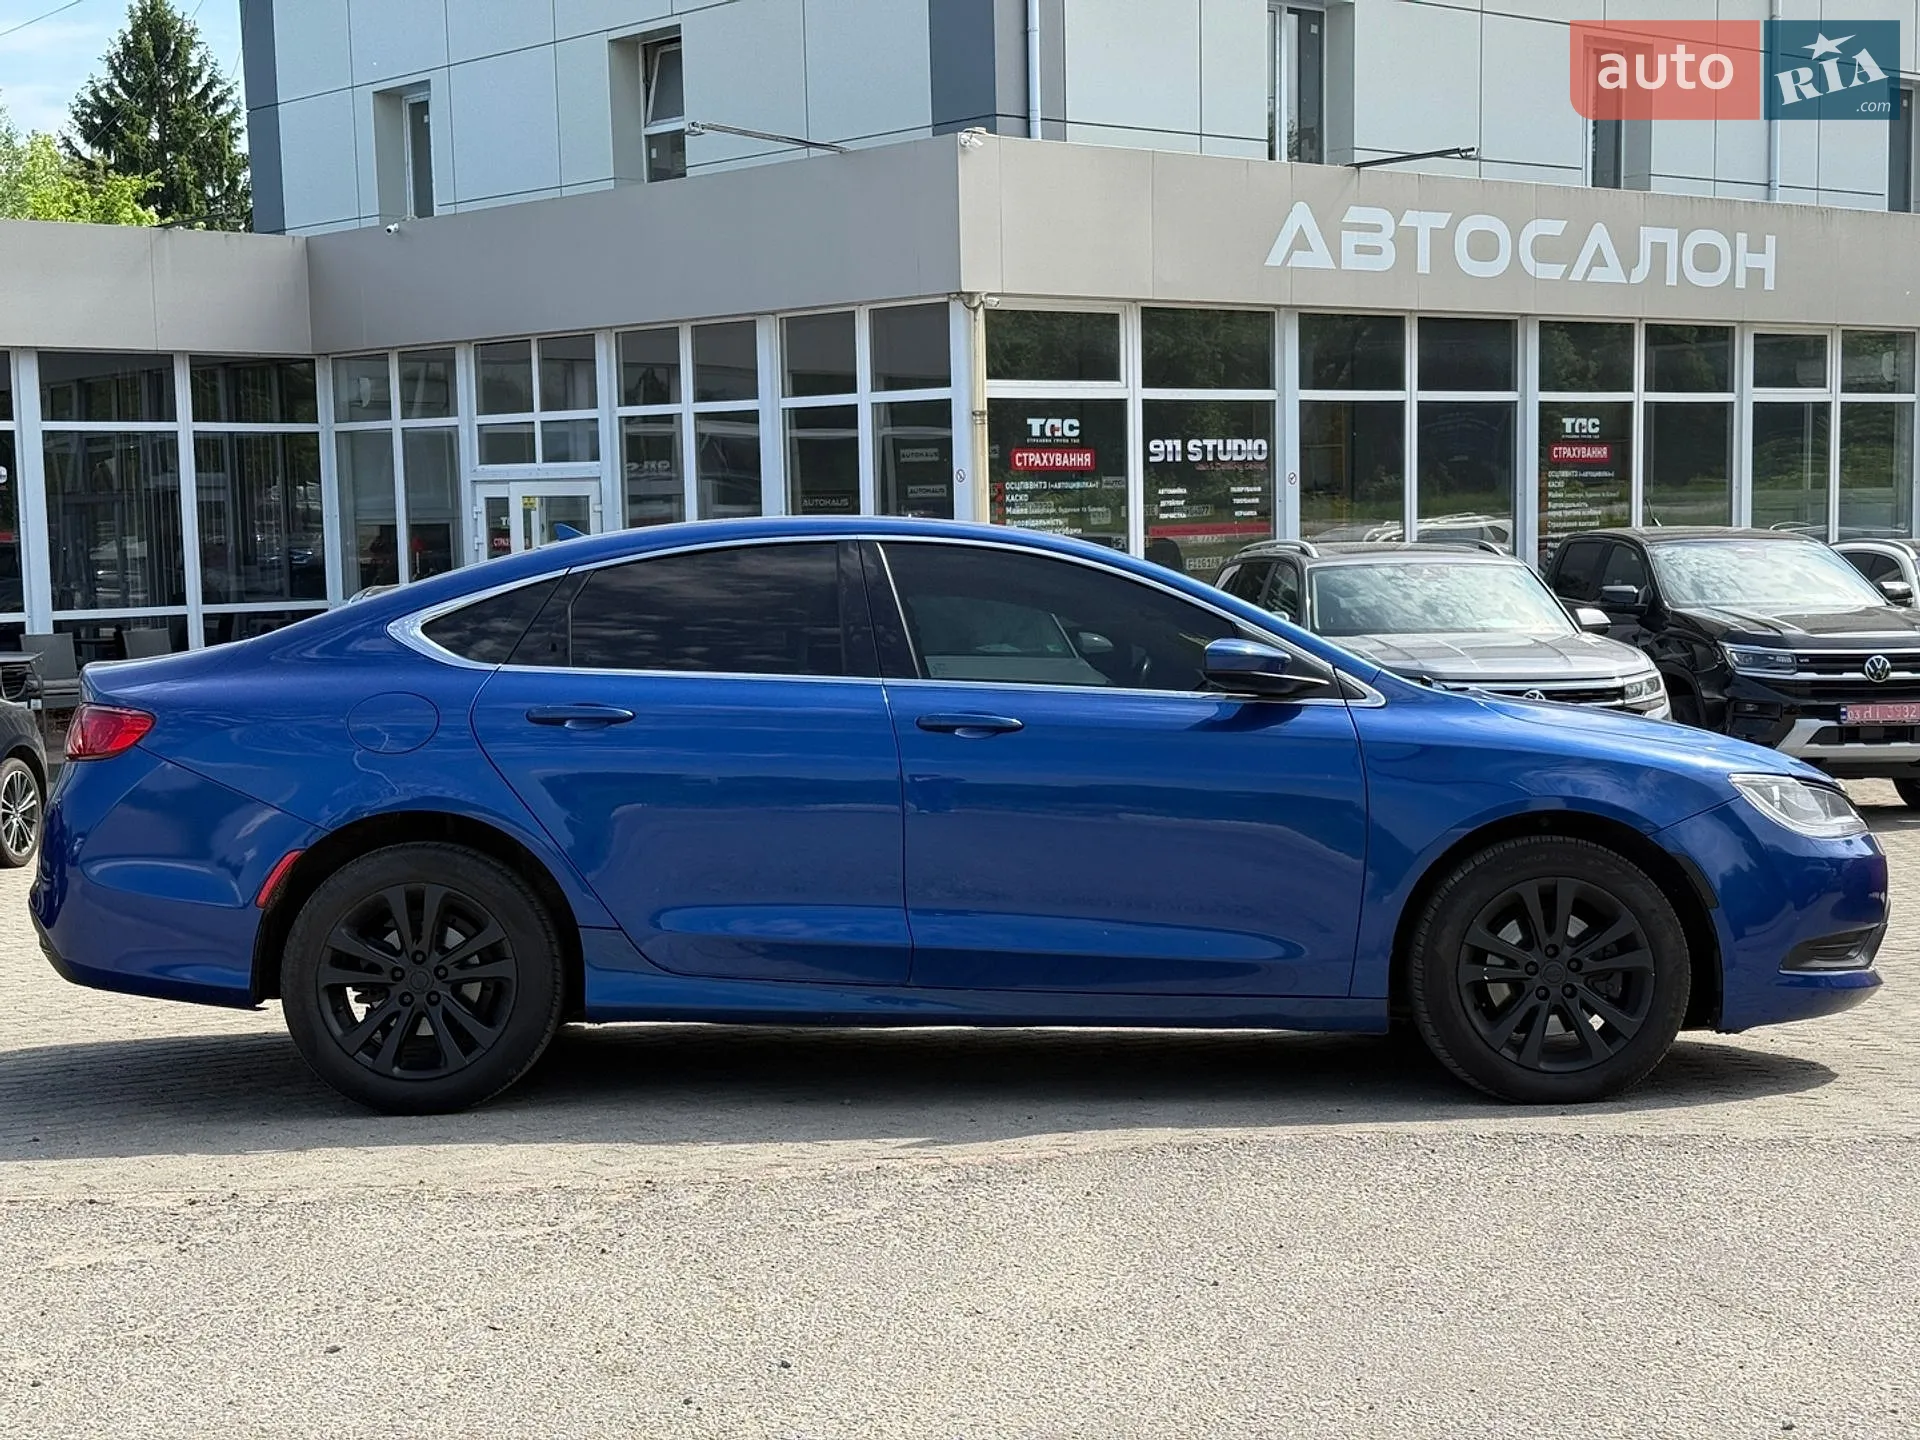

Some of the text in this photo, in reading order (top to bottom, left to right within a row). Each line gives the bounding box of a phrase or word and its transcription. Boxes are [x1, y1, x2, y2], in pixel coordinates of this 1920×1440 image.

[1264, 201, 1777, 291] АВТОСАЛОН
[1015, 452, 1091, 467] СТРАХУВАННЯ
[1149, 439, 1268, 462] 911 STUDIO
[1553, 446, 1608, 459] СТРАХУВАННЯ
